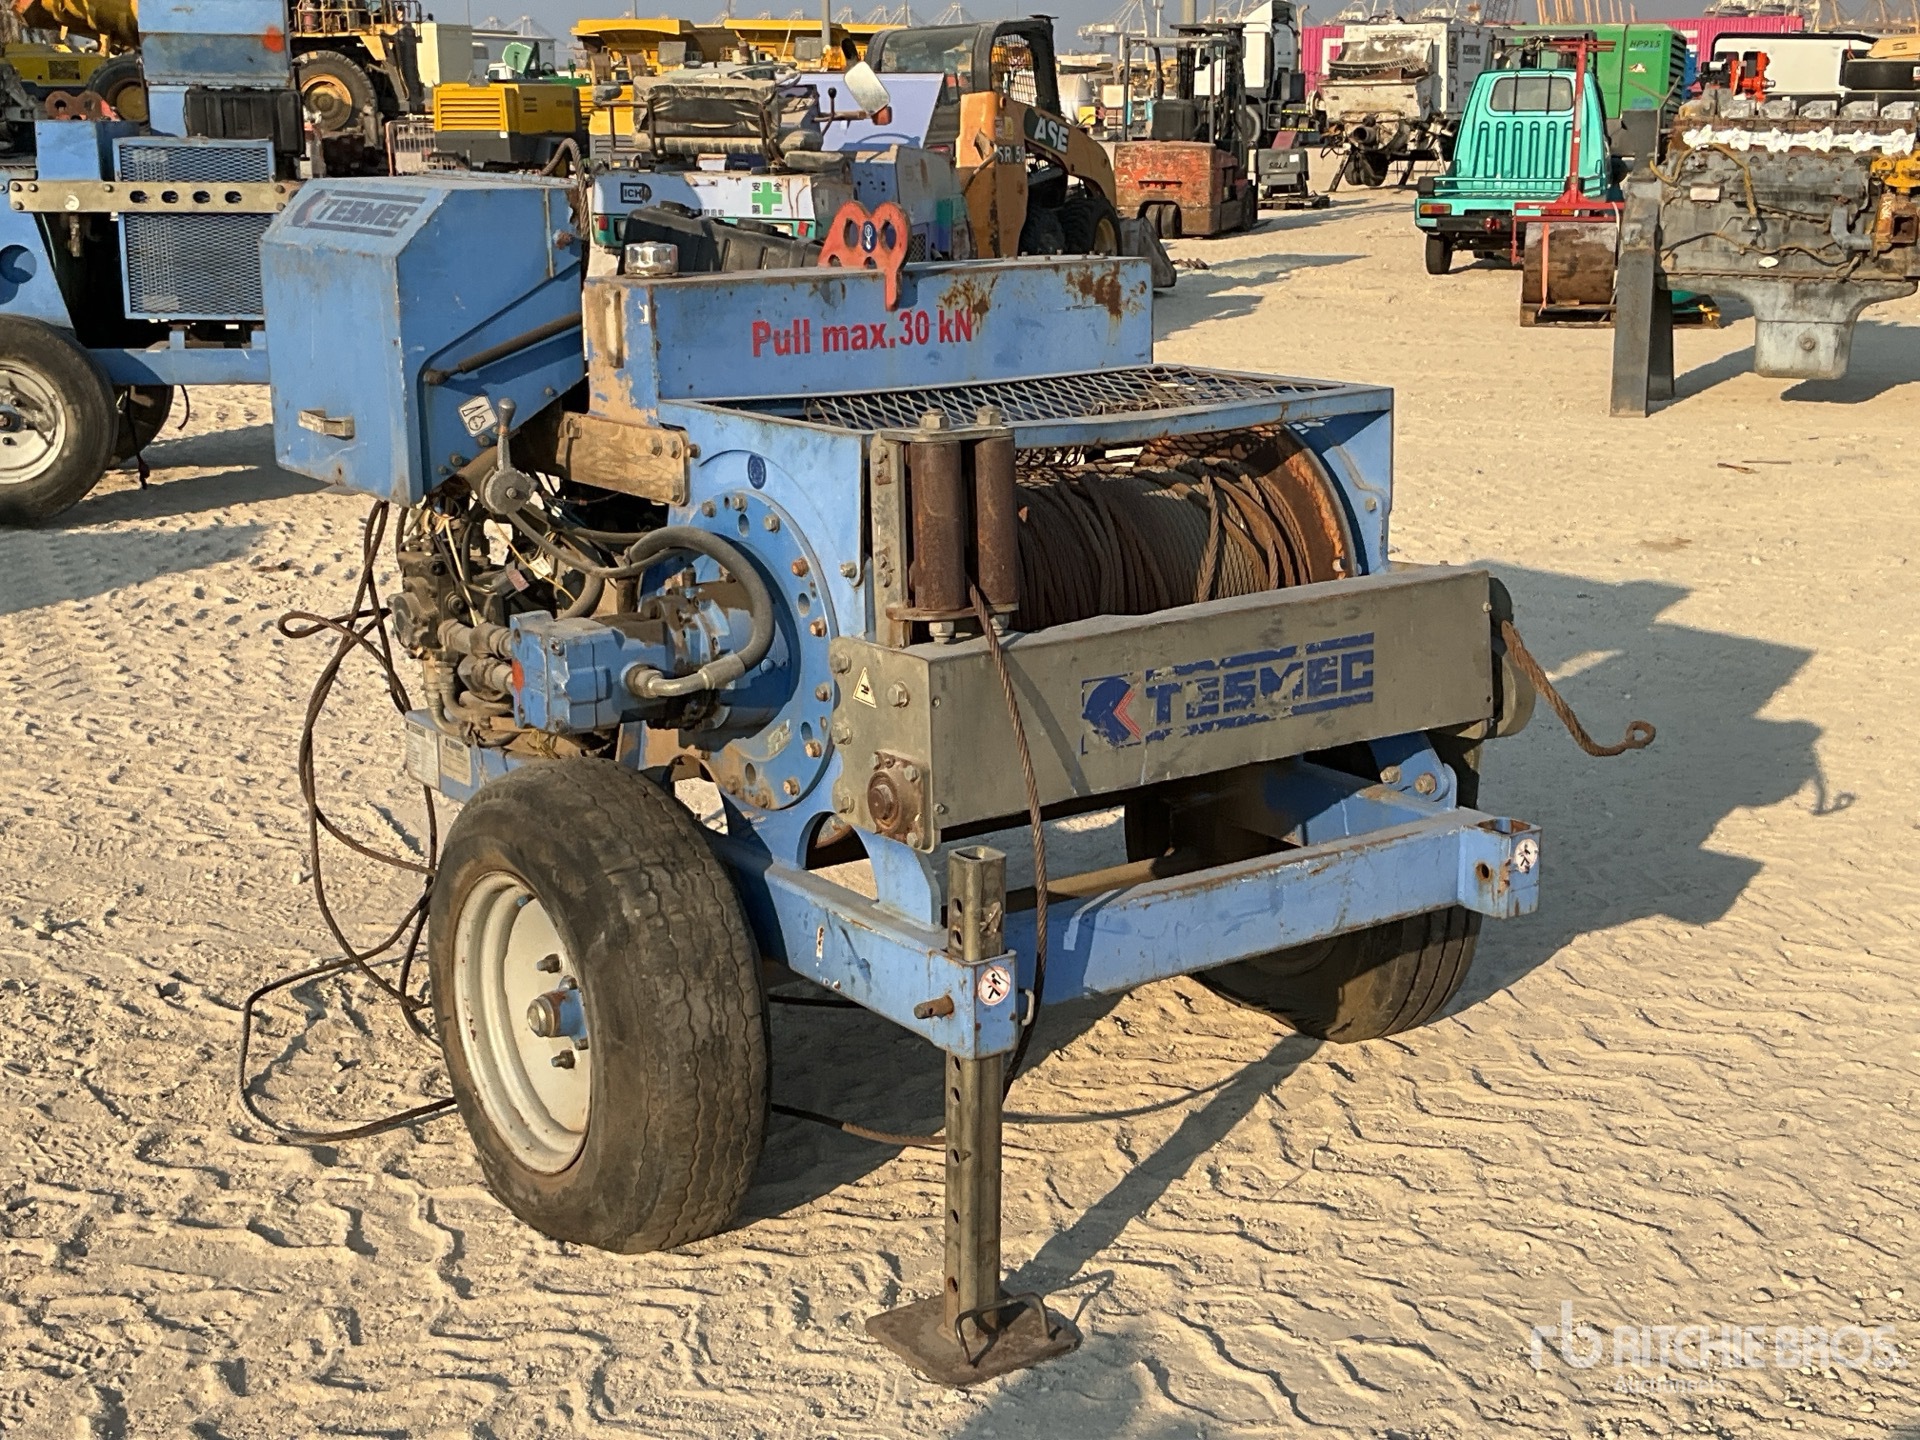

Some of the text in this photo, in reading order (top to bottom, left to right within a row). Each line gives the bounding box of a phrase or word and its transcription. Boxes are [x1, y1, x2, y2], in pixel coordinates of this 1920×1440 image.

[315, 198, 420, 229] TESMEC
[752, 319, 811, 358] Pull
[939, 308, 973, 343] kN
[1146, 648, 1375, 726] TESMEC
